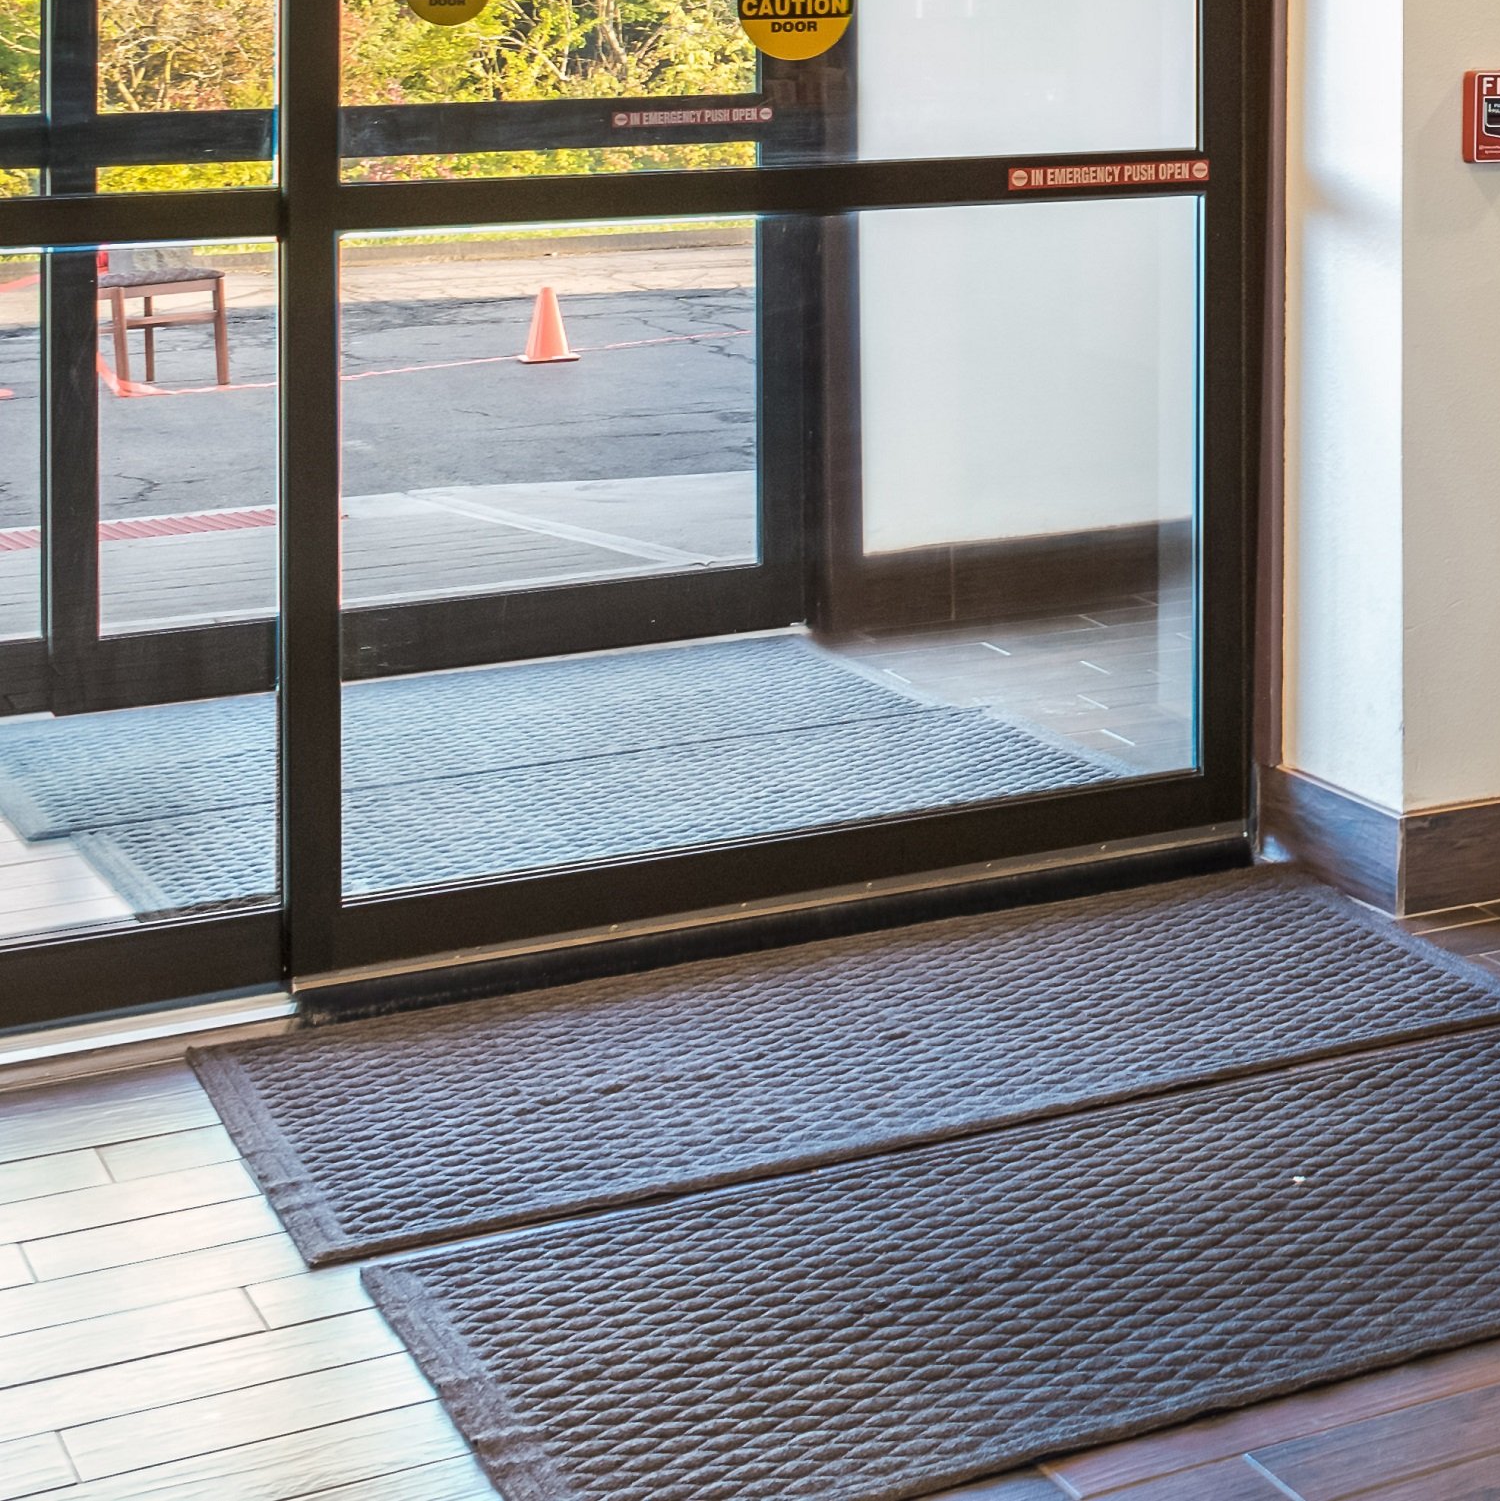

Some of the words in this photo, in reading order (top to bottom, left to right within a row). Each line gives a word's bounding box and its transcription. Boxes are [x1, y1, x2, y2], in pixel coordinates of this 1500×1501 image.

[770, 21, 818, 33] DOOR
[630, 112, 641, 125] IN
[642, 110, 702, 125] EMERGENCY
[705, 108, 730, 123] PUSH
[732, 107, 758, 121] OPEN
[1031, 169, 1043, 186] IN
[1047, 165, 1120, 186] EMERGENCY
[1124, 163, 1156, 182] PUSH
[1159, 162, 1190, 180] OPEN
